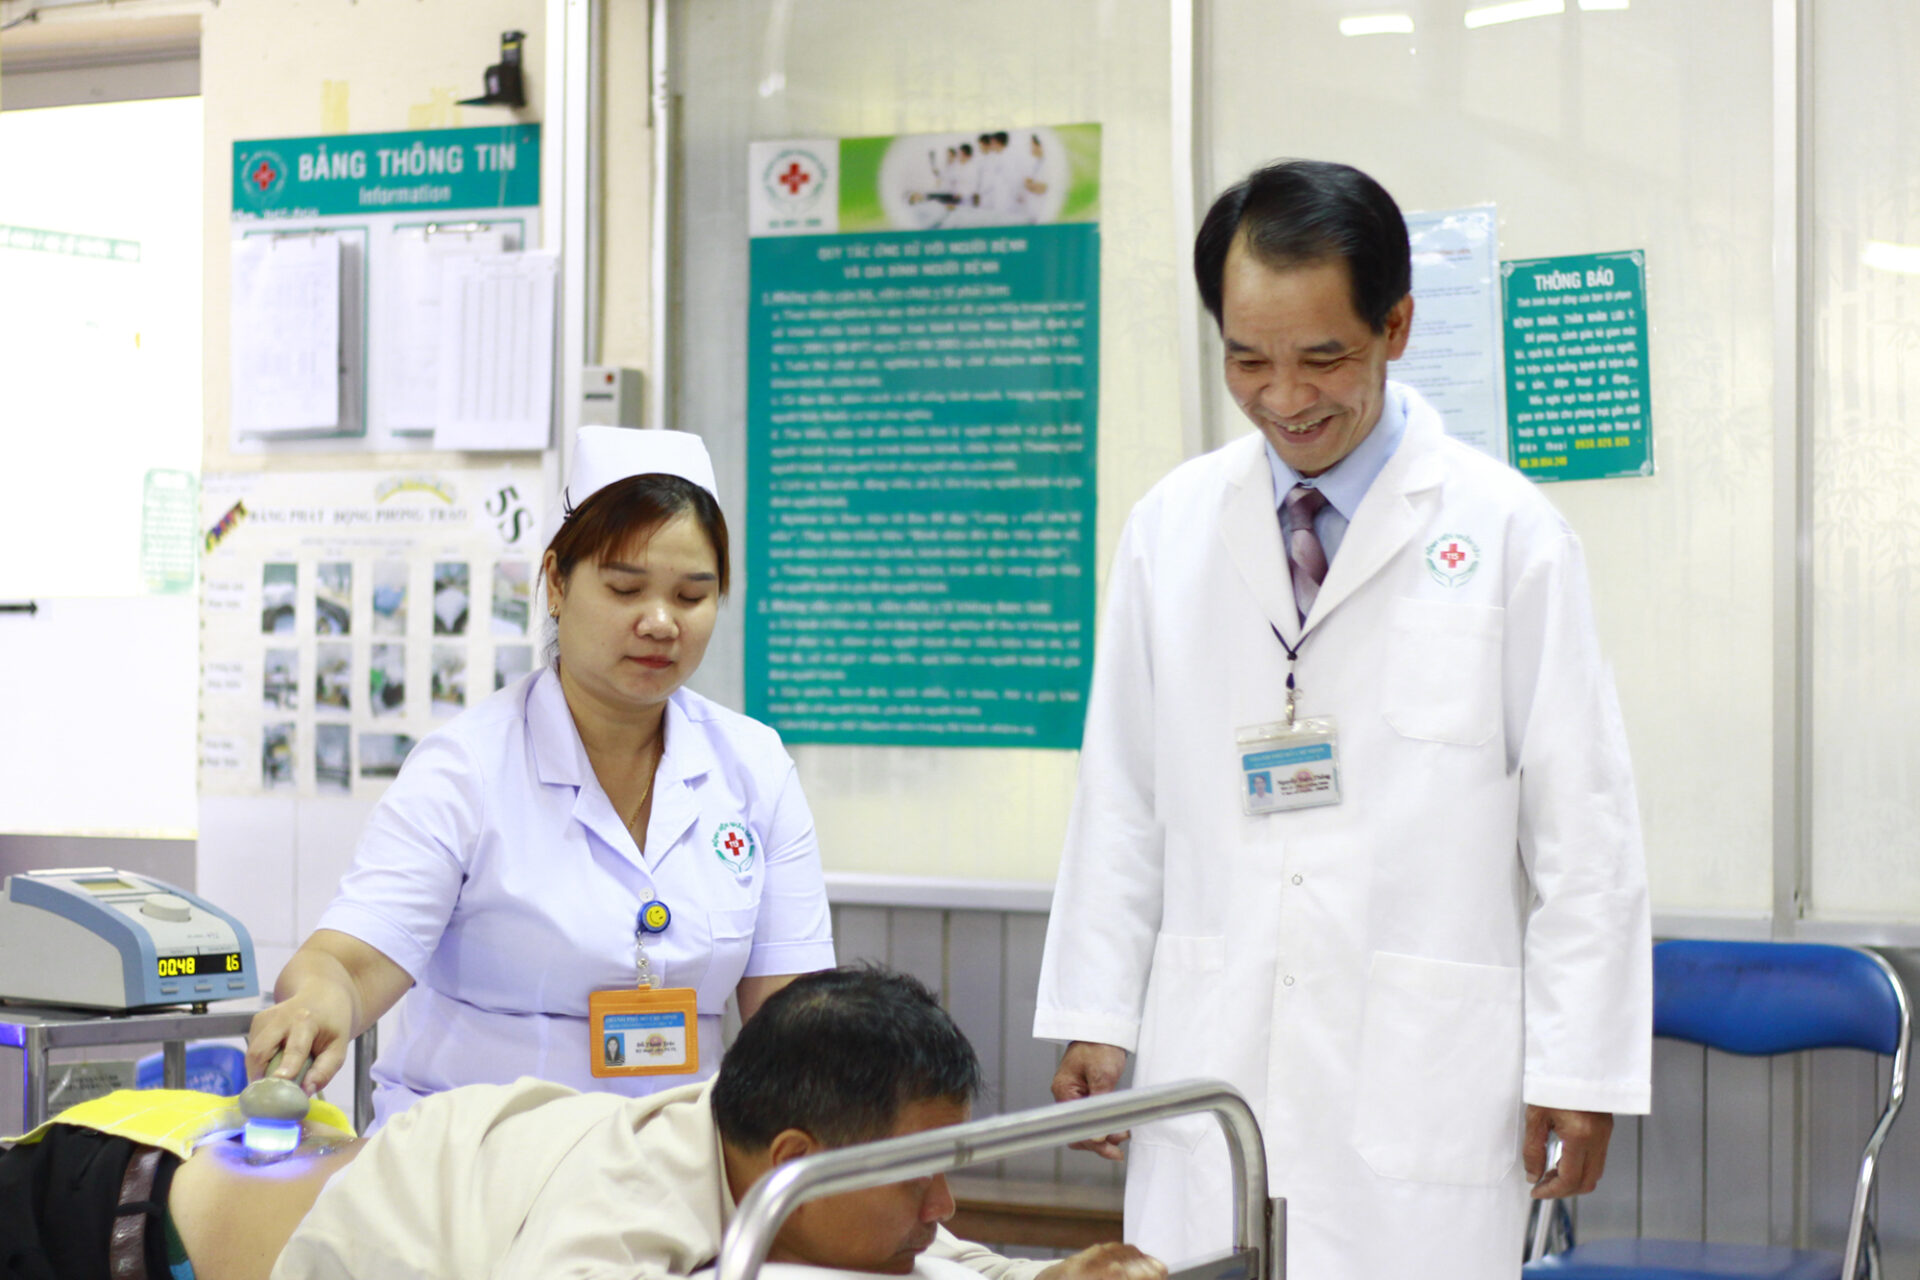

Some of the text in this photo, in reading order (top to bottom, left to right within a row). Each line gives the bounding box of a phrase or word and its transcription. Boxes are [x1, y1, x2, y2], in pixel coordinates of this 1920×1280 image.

[299, 146, 366, 181] BẢNG
[376, 141, 463, 177] THÔNG
[474, 143, 517, 172] TIN
[358, 185, 451, 206] Information
[1533, 265, 1615, 291] THÔNG BÁO
[485, 485, 534, 543] 5S
